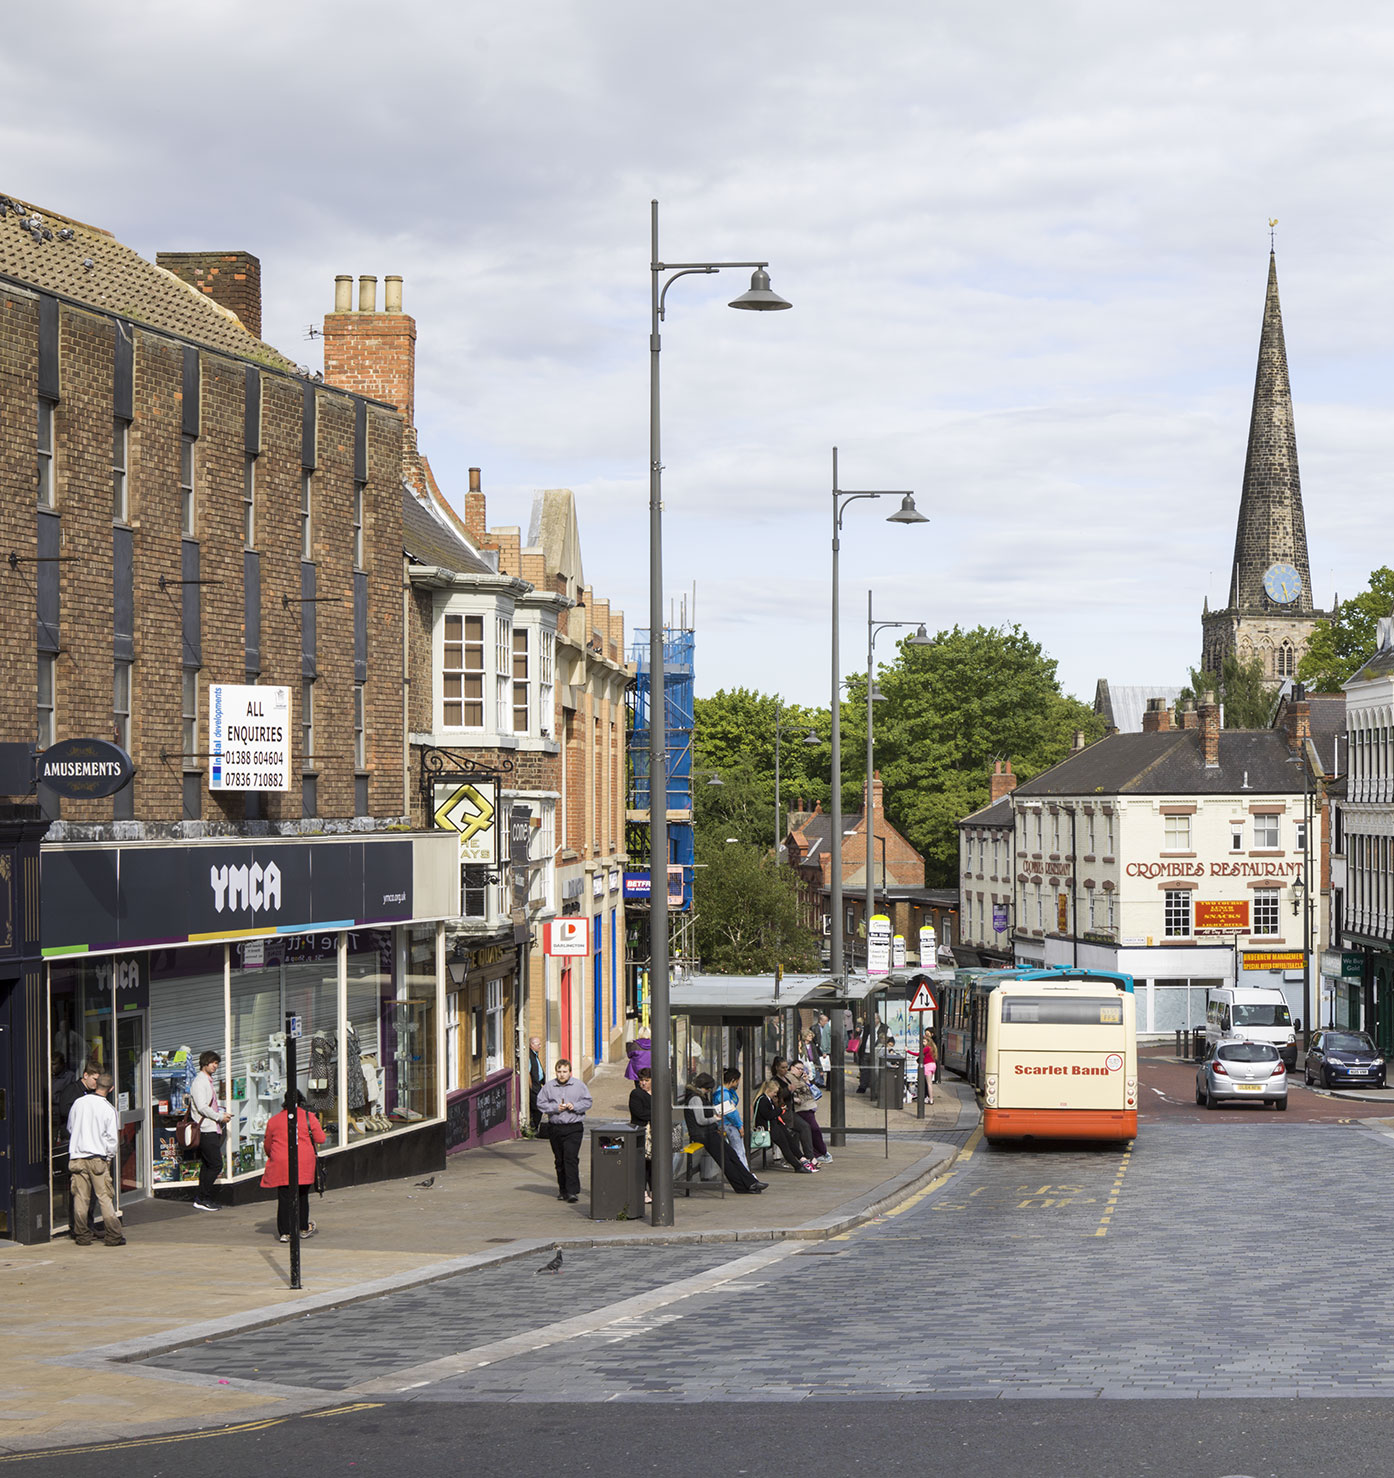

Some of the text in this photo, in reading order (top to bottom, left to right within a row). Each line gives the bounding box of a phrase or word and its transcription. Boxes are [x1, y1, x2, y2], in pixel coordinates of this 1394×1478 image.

[214, 687, 222, 738] developments
[246, 701, 264, 717] ALL
[228, 726, 283, 745] ENQUIRIES
[226, 750, 284, 766] 01388 604604
[44, 762, 121, 777] AMUSEMENTS
[226, 772, 284, 788] 07836 710882
[460, 850, 491, 859] AYS
[1126, 862, 1304, 880] CROMBIES RESTAURANT
[210, 860, 282, 913] YMCA
[382, 891, 407, 905] ymca.org.uk
[1014, 1064, 1068, 1075] Scarlet
